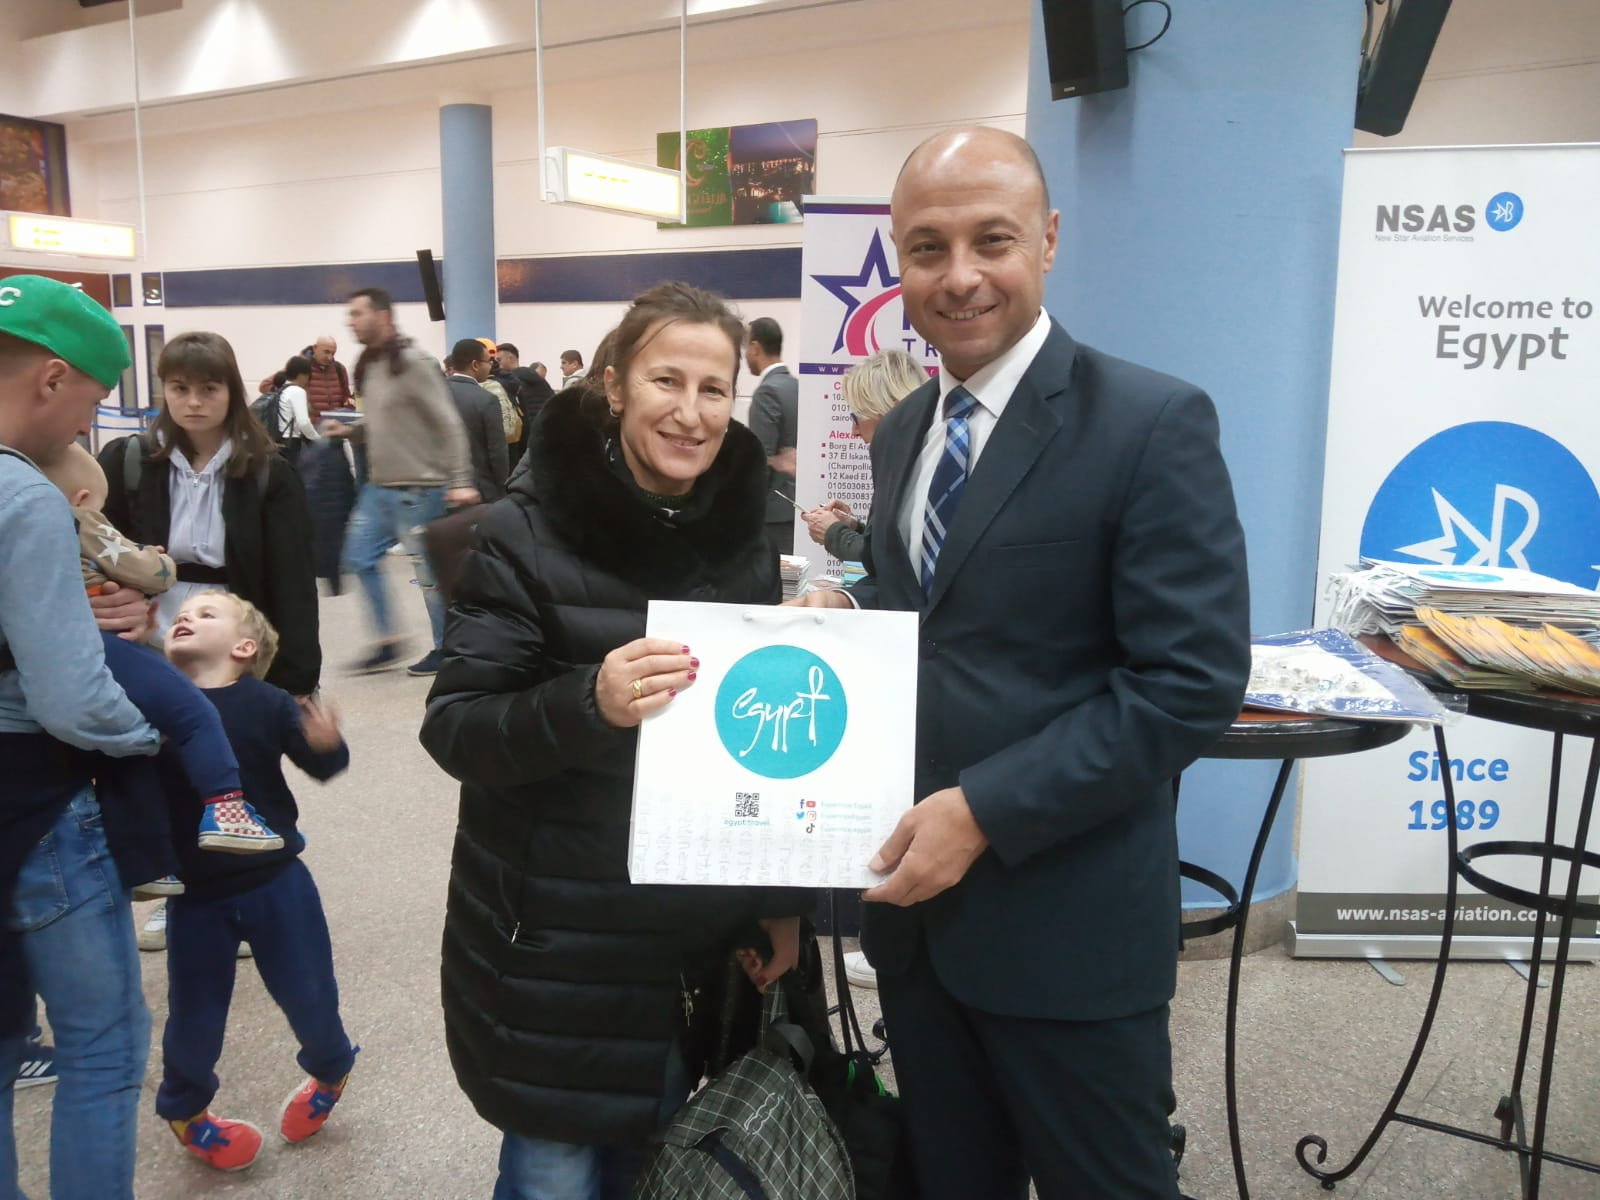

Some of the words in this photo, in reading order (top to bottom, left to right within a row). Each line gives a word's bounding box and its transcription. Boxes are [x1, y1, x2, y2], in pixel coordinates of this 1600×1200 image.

[1375, 204, 1476, 233] NSAS
[1394, 233, 1409, 242] Star
[1411, 233, 1441, 242] Aviation
[1418, 294, 1553, 319] Welcome
[1561, 297, 1593, 319] to
[1436, 325, 1569, 371] Egypt
[828, 452, 838, 460] 37
[840, 452, 847, 460] El
[829, 441, 847, 451] Borg
[849, 442, 856, 450] El
[828, 472, 838, 480] 12
[1407, 750, 1509, 782] Since
[1407, 799, 1500, 830] 1989
